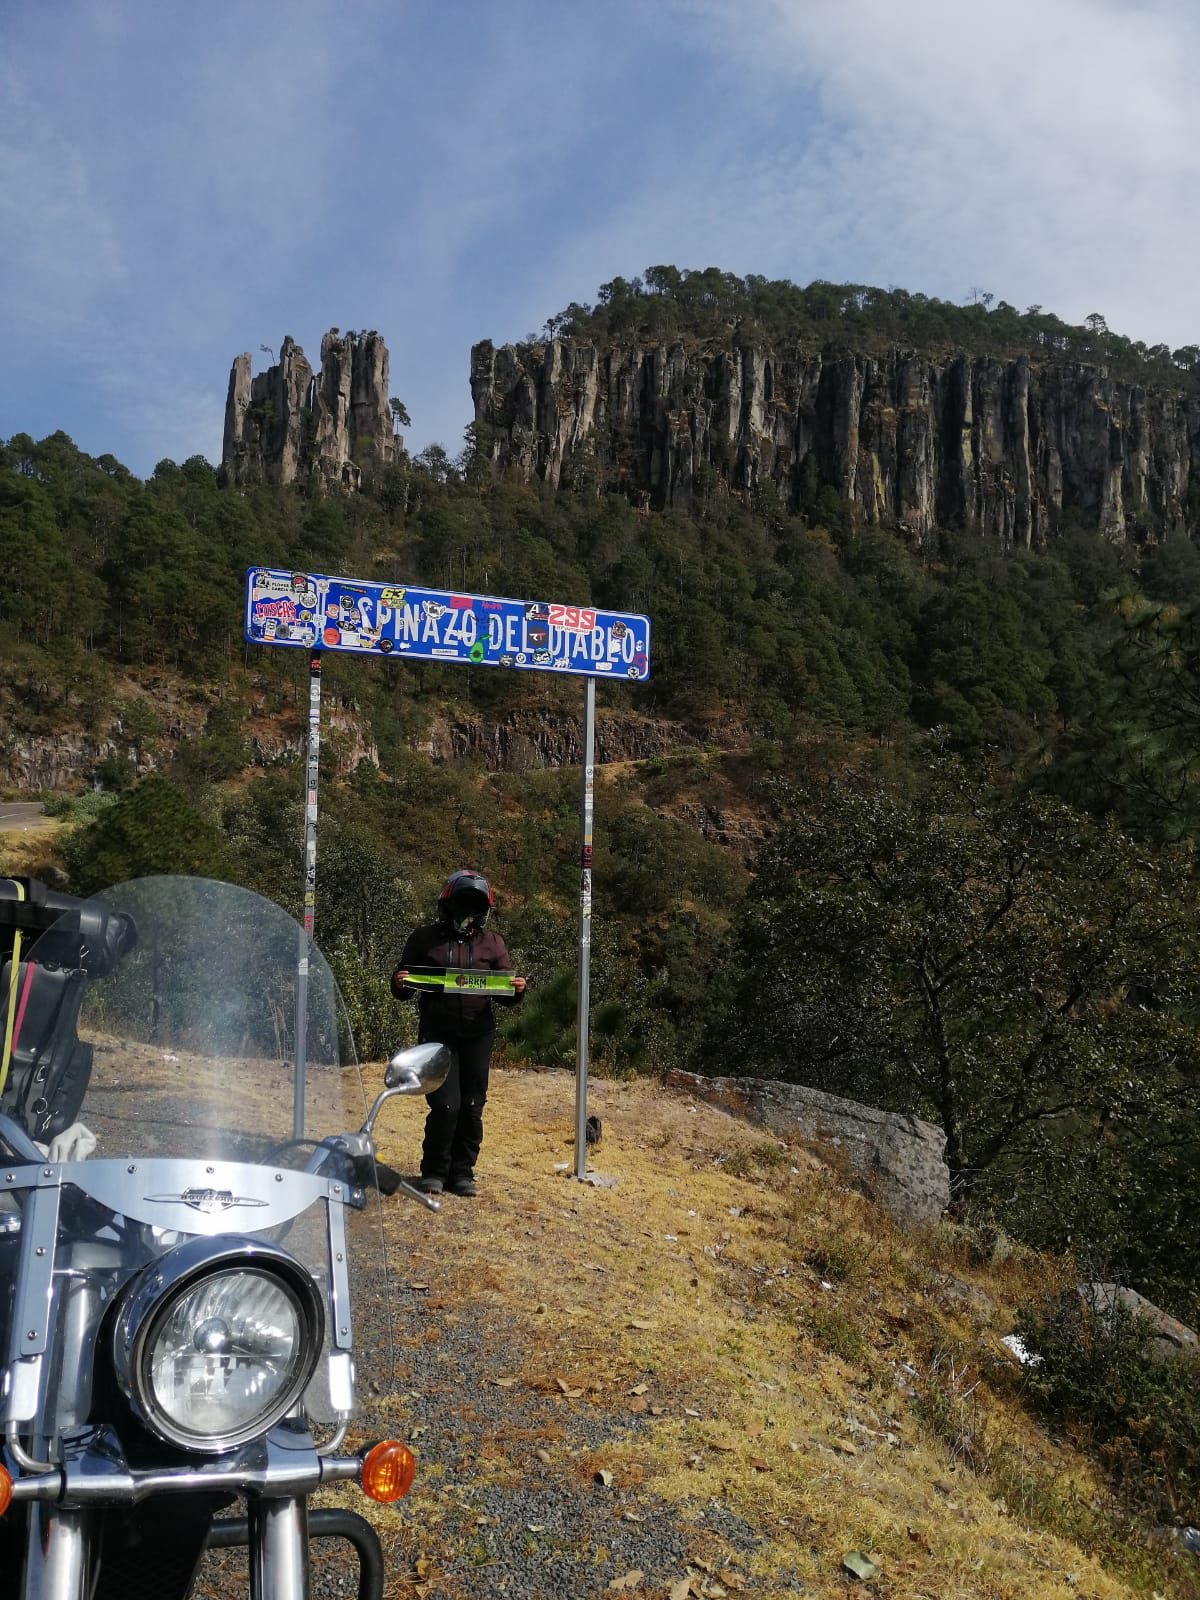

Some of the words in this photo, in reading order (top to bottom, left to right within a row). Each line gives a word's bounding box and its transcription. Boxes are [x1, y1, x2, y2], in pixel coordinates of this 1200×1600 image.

[380, 587, 406, 601] 63
[549, 605, 596, 630] 299
[488, 613, 535, 654] DEL
